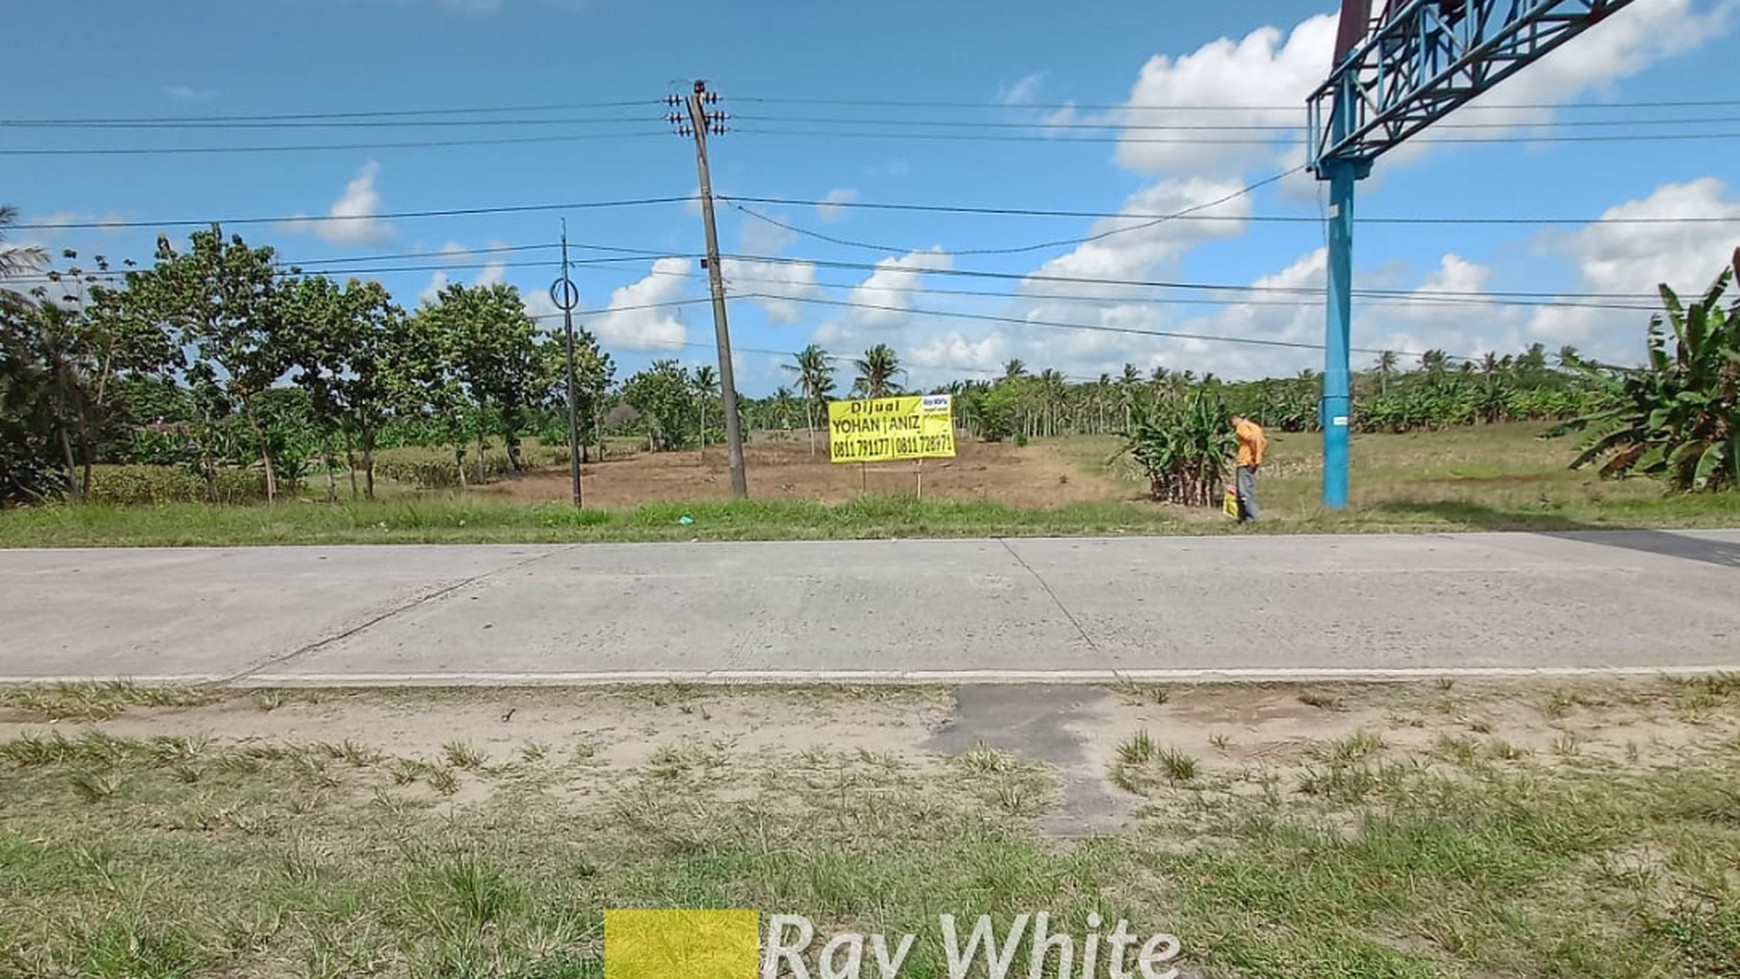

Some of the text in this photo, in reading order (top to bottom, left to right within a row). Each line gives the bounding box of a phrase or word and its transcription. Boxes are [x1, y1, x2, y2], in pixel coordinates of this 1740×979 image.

[851, 400, 900, 414] Dijual
[832, 415, 920, 434] YOHAN ANIZ
[834, 439, 855, 457] 0811
[896, 436, 918, 453] 0811
